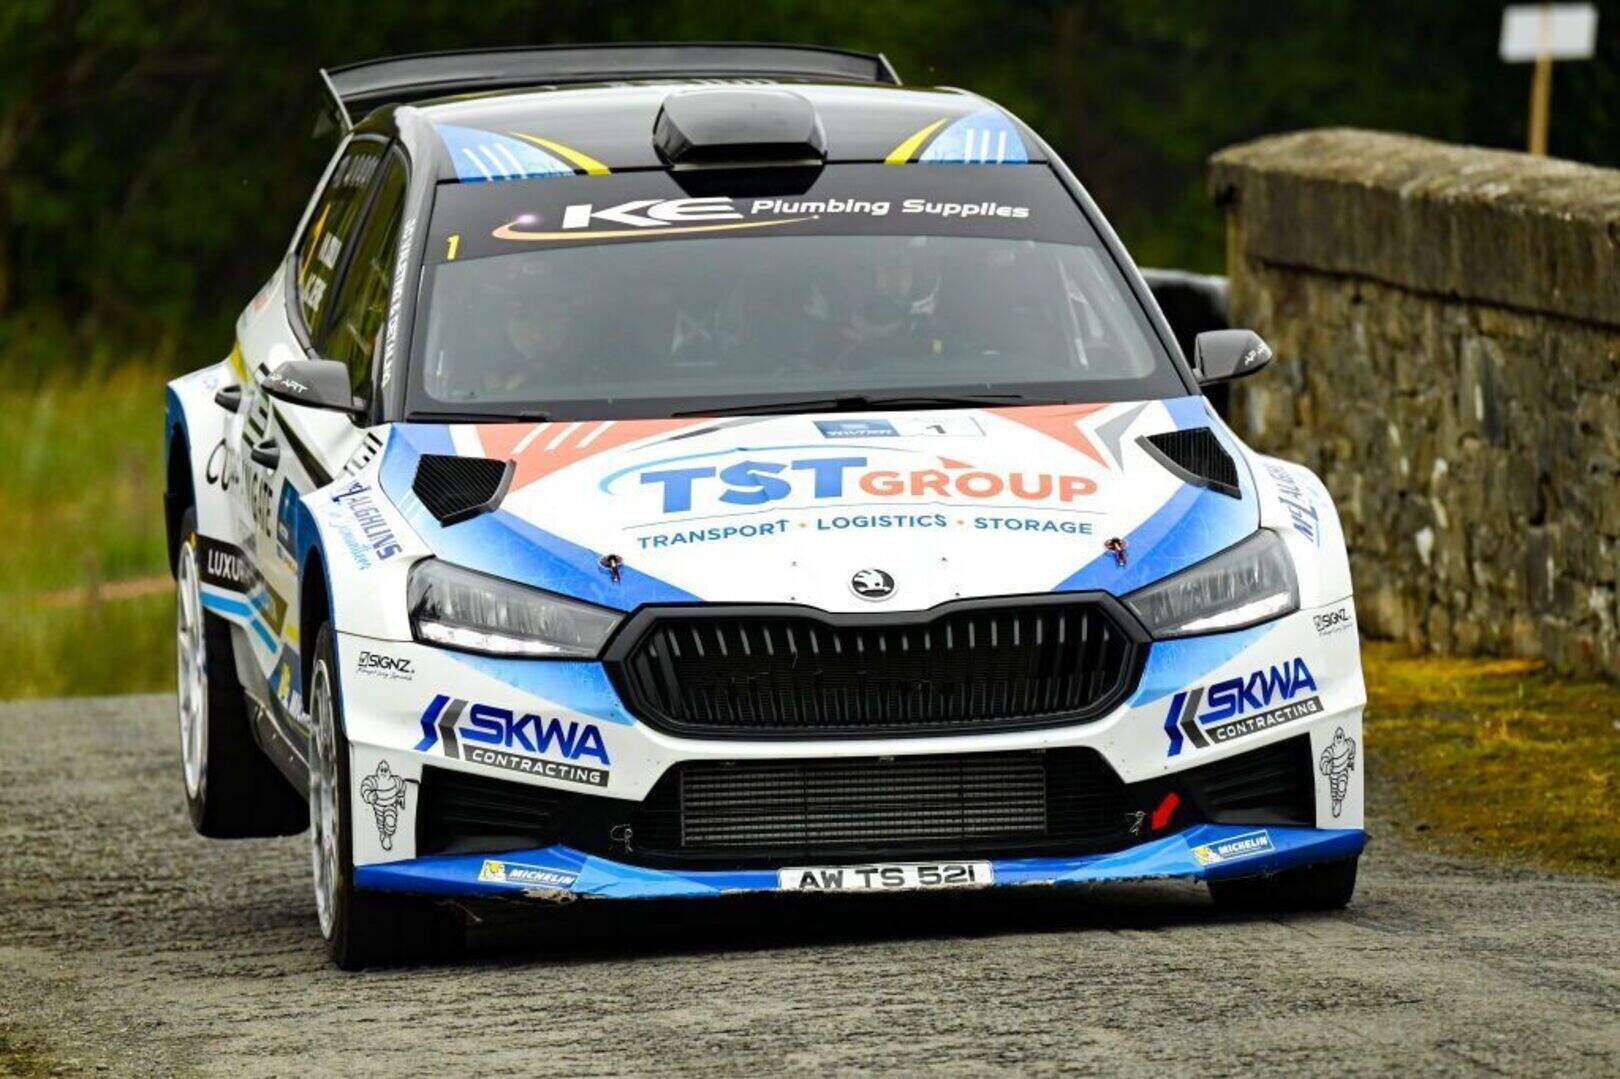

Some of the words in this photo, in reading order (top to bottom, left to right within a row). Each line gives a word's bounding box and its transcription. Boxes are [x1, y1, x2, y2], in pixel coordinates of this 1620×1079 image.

[562, 197, 744, 228] KE
[750, 198, 889, 217] Plumbing
[902, 200, 1030, 219] Supplies
[446, 234, 459, 259] 1
[637, 519, 788, 550] TRANSPORT
[817, 512, 947, 531] LOGISTICS
[974, 516, 1093, 536] STORAGE
[1200, 657, 1317, 725] SKWA
[460, 703, 611, 765] SKWA
[1216, 700, 1317, 740] CONTRACTING
[471, 749, 601, 784] CONTRACTING
[1218, 836, 1268, 854] MICHELIN
[509, 869, 575, 884] MICHELIN
[799, 869, 843, 889] AW
[855, 867, 905, 888] TS
[917, 864, 976, 885] 521
